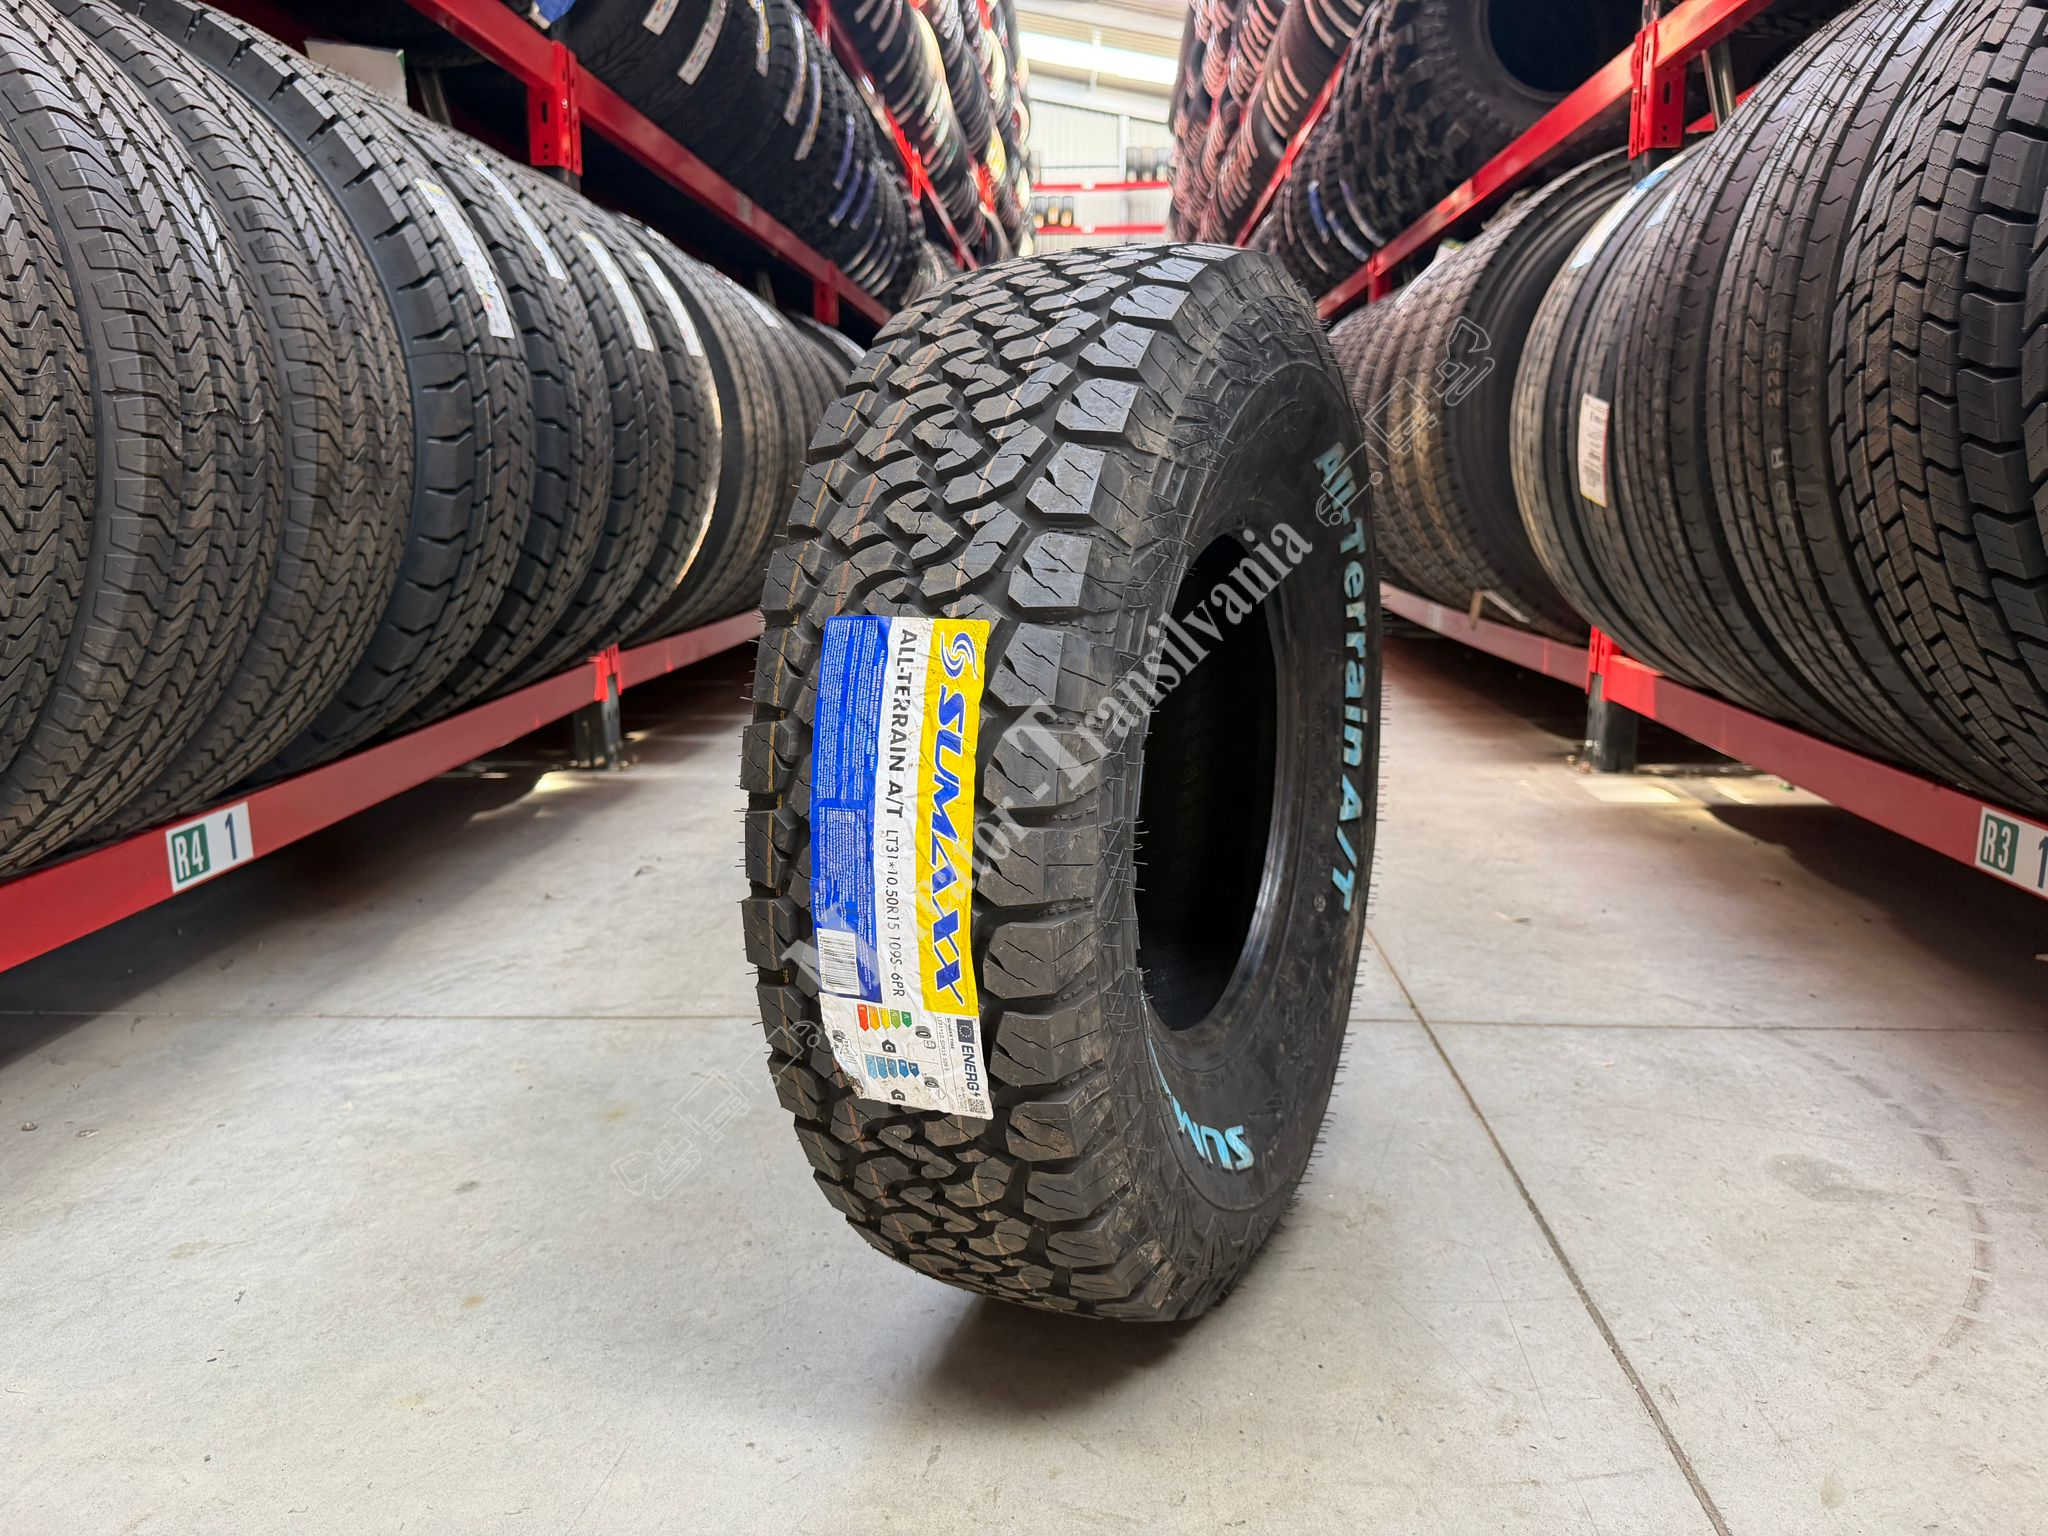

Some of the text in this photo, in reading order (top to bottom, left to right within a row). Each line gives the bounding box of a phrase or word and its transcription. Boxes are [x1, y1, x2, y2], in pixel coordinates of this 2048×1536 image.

[889, 629, 917, 771] ALL-TERRAIN
[1314, 442, 1368, 912] All-Terrain A/T
[886, 780, 904, 818] A/T
[175, 813, 237, 880] R4 1
[932, 685, 965, 1006] SUMAXX
[1983, 820, 2048, 889] R3 1
[962, 1045, 980, 1091] ENERG
